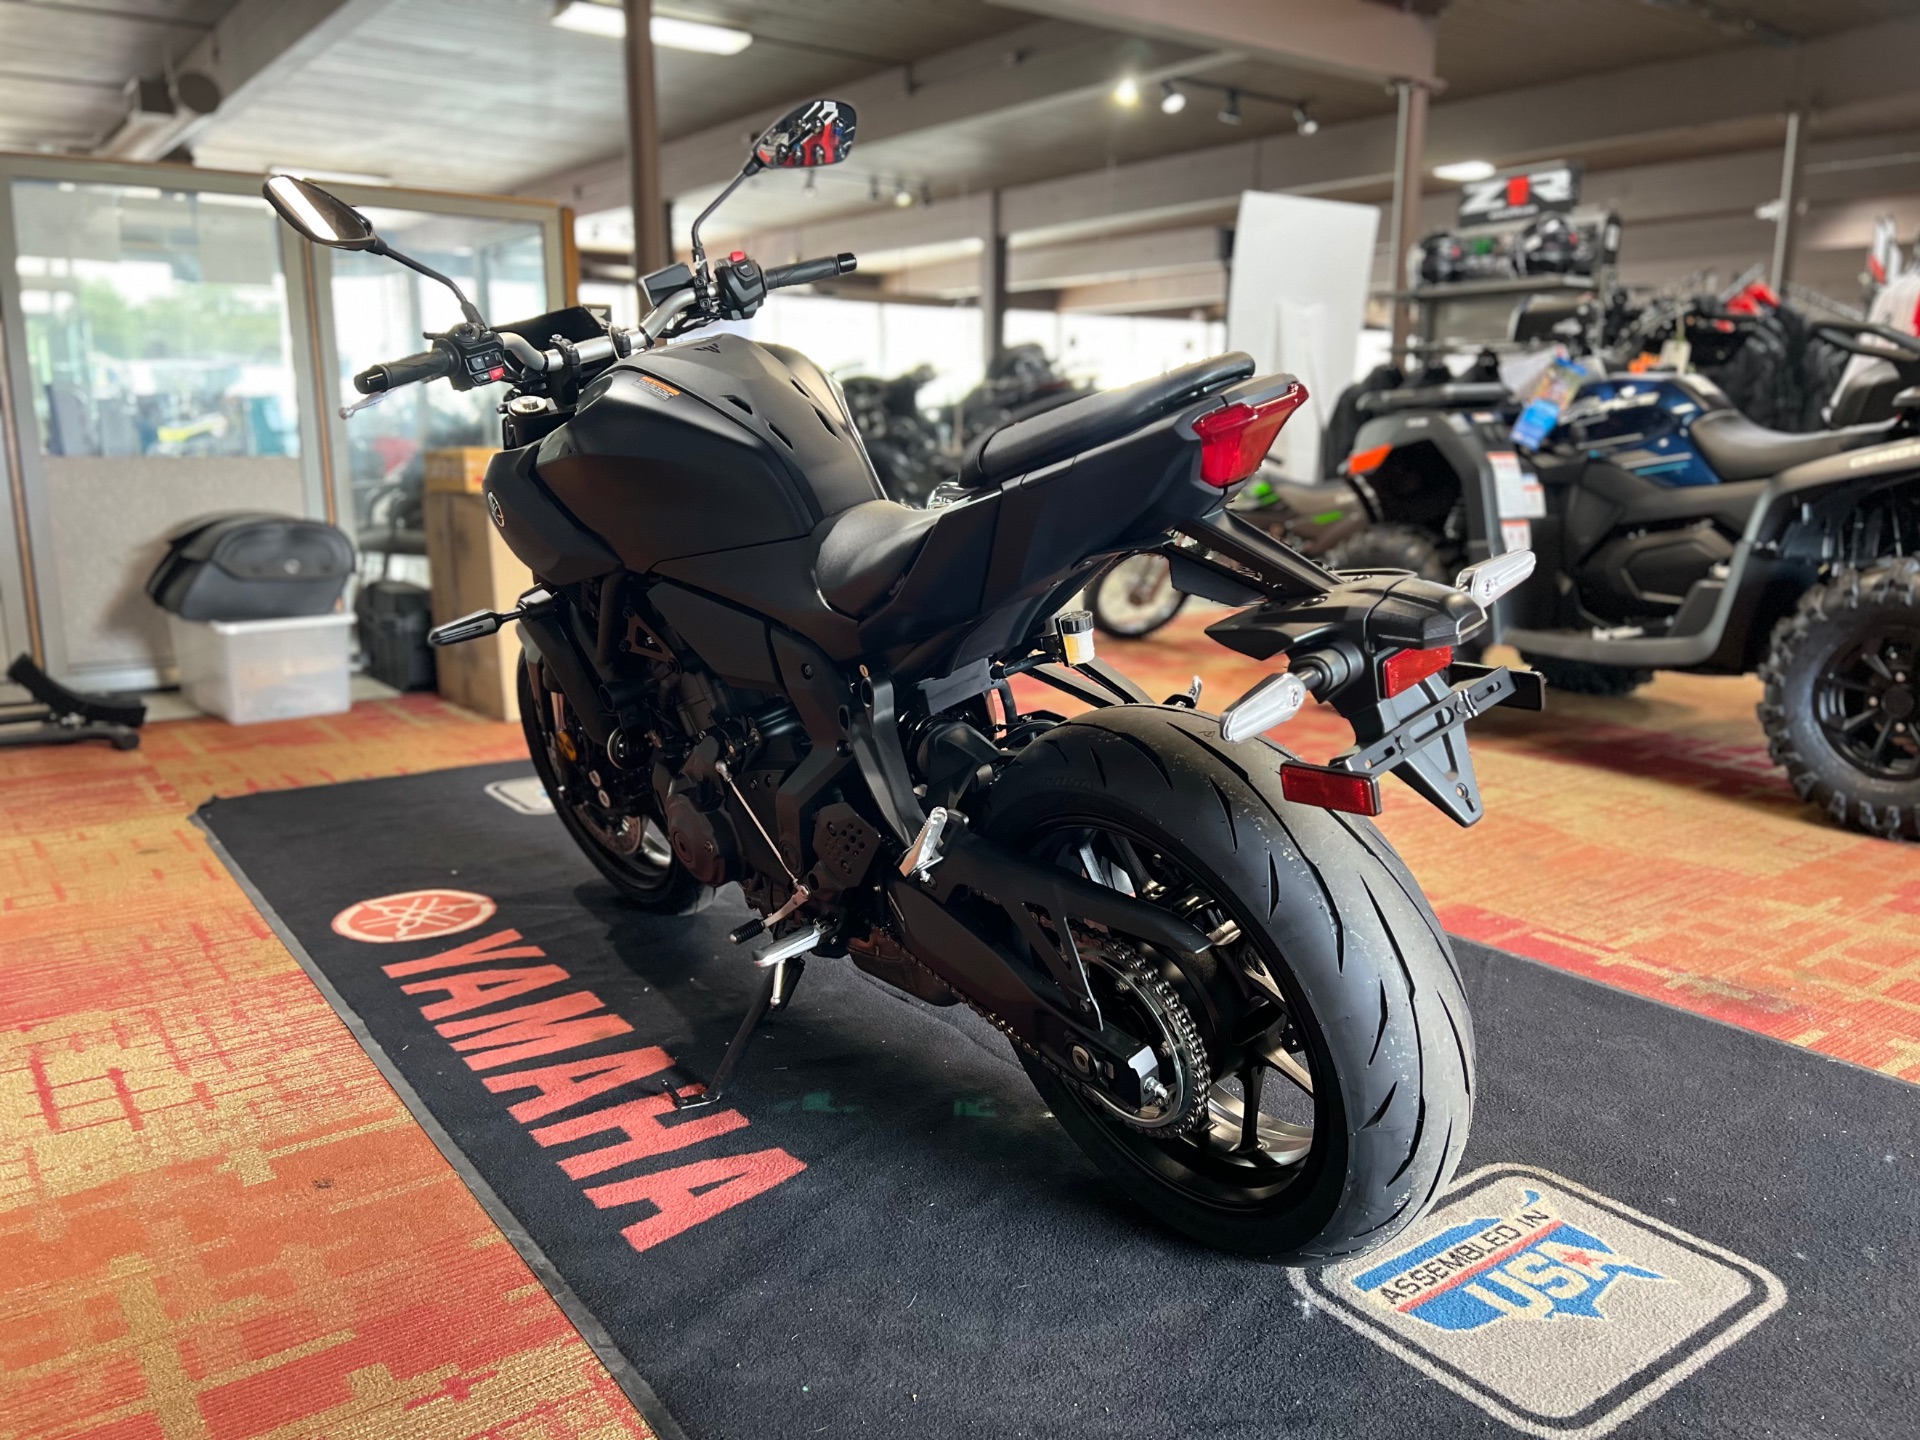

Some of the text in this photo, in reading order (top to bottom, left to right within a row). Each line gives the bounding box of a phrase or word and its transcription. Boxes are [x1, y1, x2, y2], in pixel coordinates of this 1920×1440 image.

[381, 928, 808, 1253] YAMAHA
[1380, 1209, 1550, 1304] ASSEMBLED IN
[1463, 1240, 1611, 1319] USA
